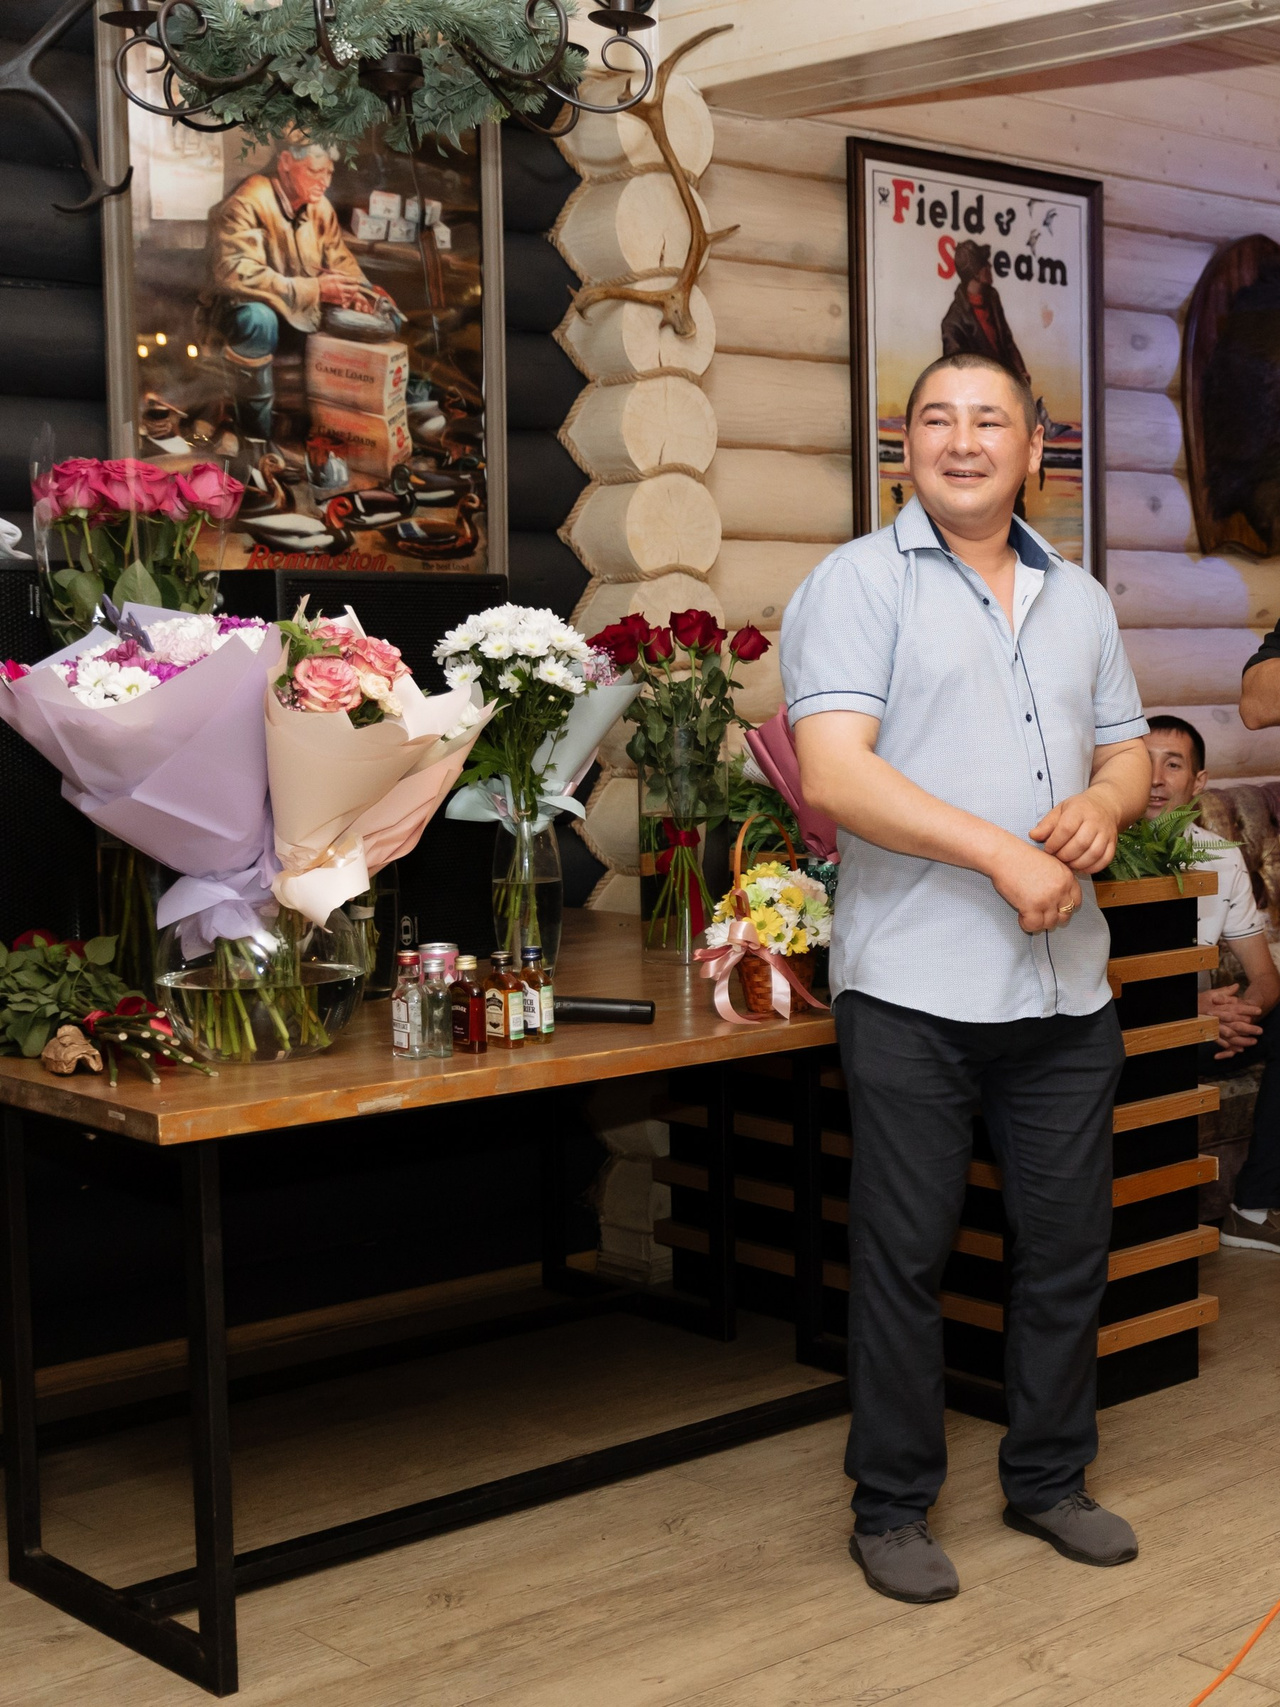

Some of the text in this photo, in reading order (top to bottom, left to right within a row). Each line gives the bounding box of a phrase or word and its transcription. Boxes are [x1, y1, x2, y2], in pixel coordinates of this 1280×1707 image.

[892, 178, 1016, 236] Field &
[937, 234, 1068, 287] Seam
[345, 369, 375, 384] LOADS
